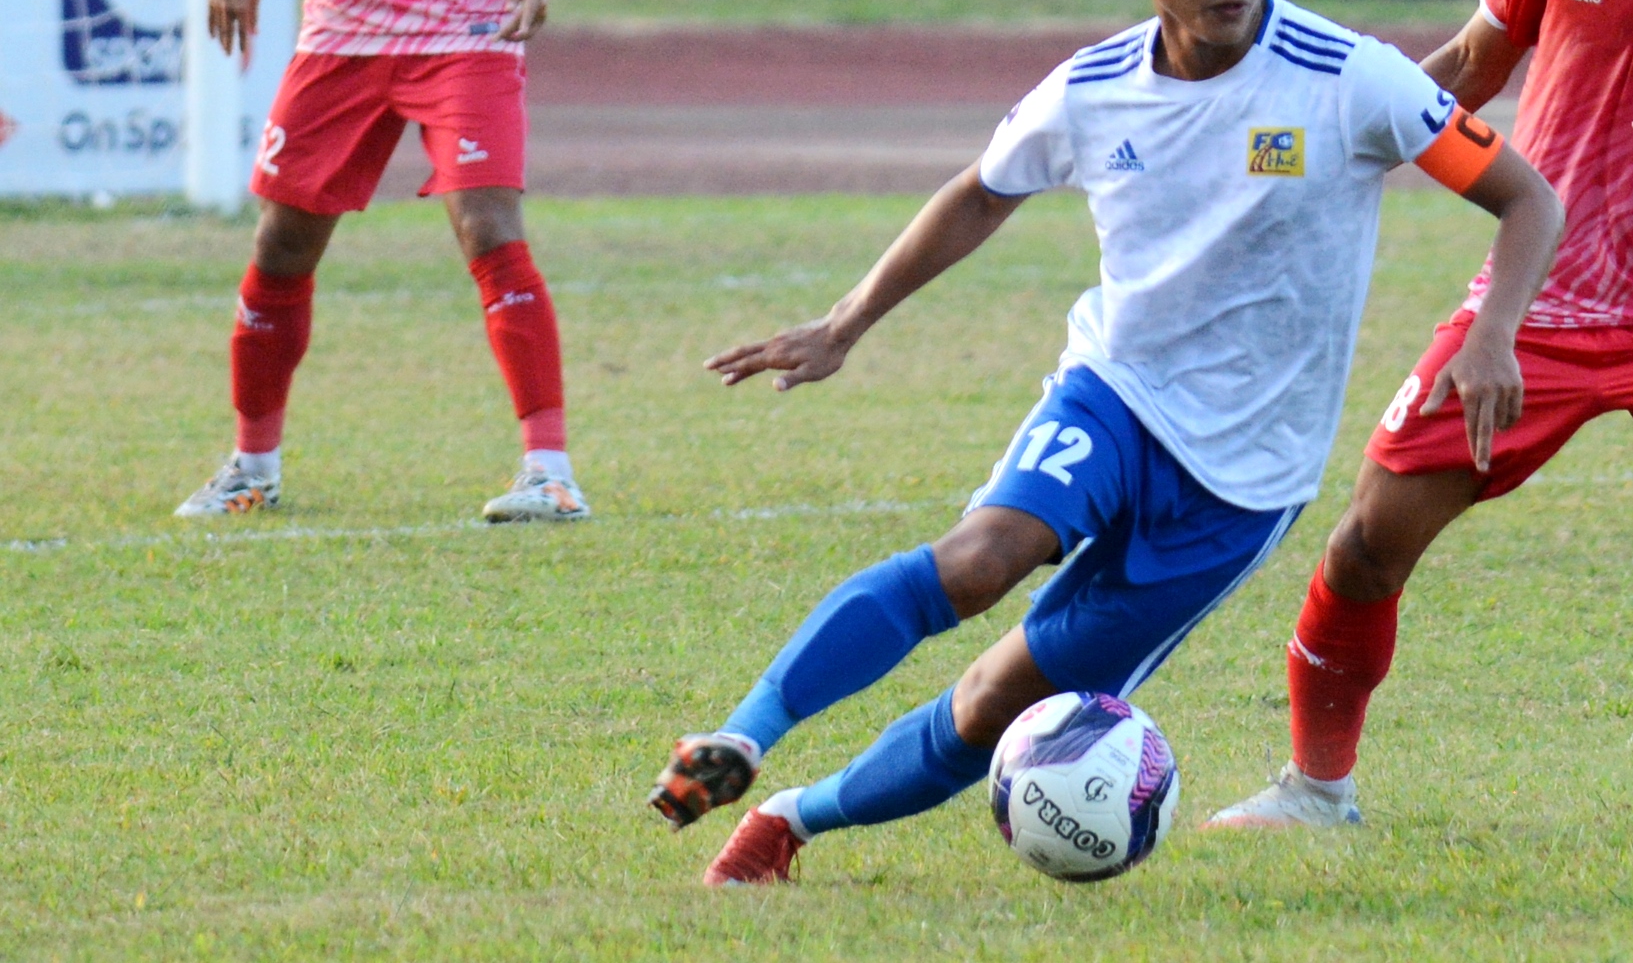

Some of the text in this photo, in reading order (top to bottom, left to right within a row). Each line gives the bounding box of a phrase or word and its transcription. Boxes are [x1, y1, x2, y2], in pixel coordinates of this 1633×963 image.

[1105, 158, 1144, 171] adidas
[1017, 421, 1093, 486] 12
[1023, 781, 1117, 859] COBRA
